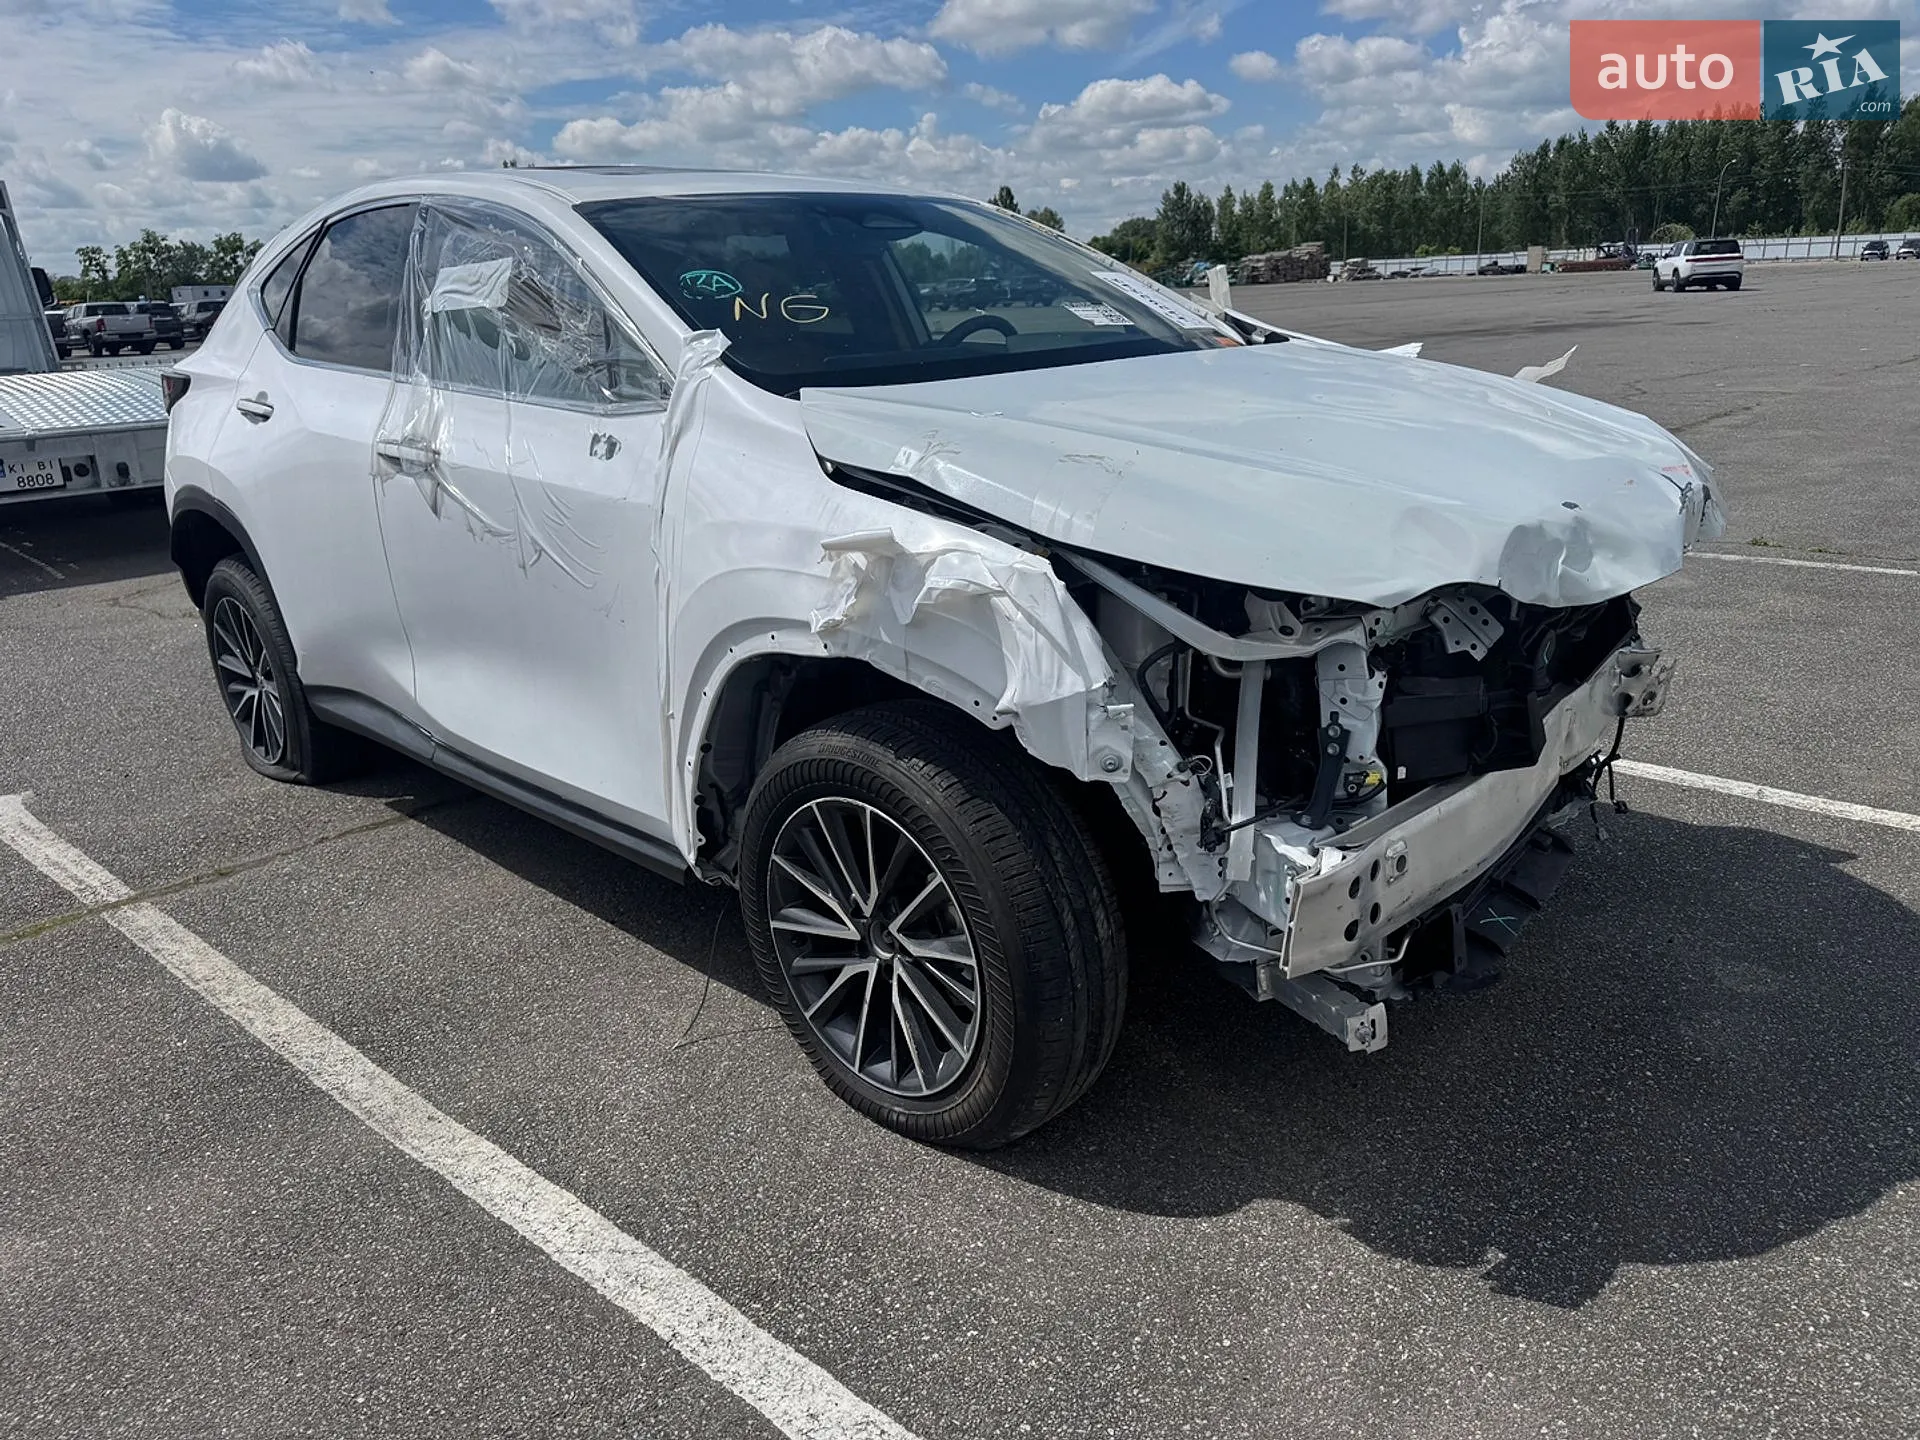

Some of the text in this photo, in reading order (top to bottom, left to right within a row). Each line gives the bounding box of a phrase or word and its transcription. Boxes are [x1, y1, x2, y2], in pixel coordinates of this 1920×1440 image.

[8, 460, 54, 474] KI BI
[17, 473, 55, 488] 8808
